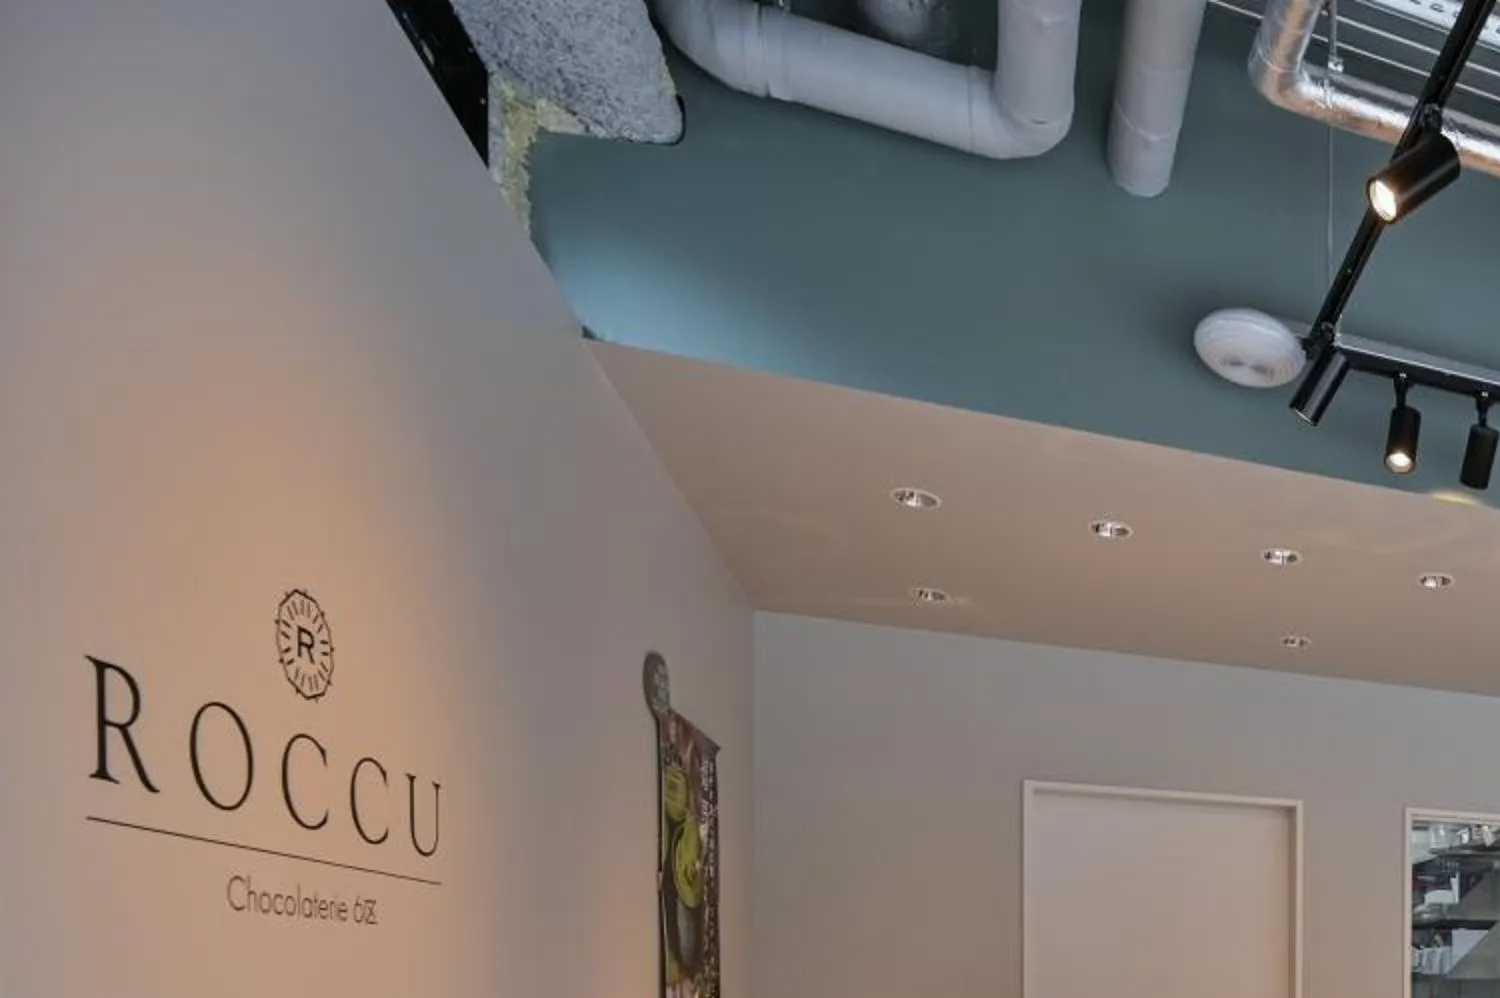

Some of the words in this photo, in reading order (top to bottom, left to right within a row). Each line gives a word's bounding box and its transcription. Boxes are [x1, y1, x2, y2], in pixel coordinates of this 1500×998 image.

[297, 625, 315, 664] R
[84, 654, 441, 857] ROCCU
[226, 874, 349, 922] Chocolaterie
